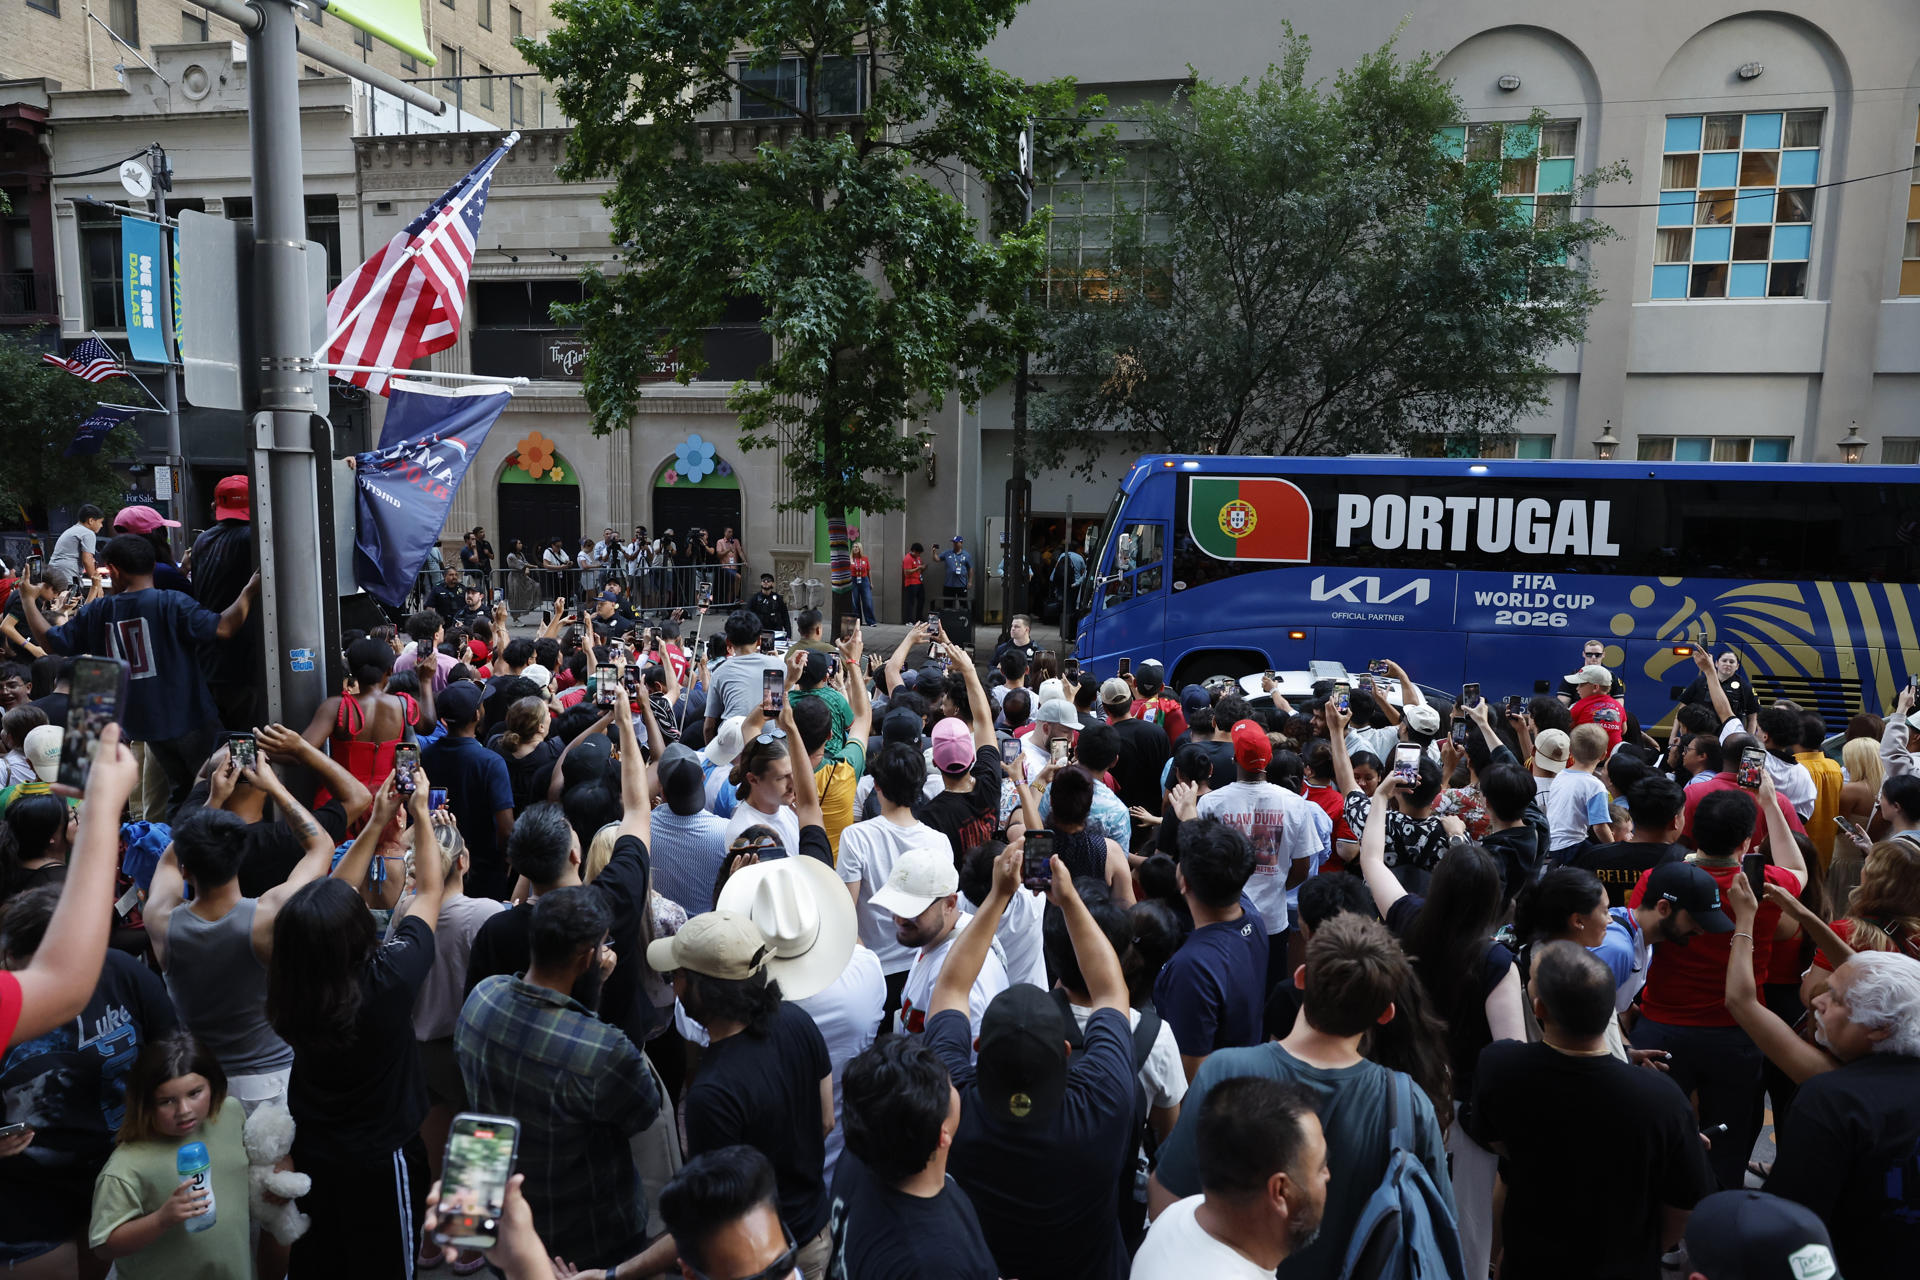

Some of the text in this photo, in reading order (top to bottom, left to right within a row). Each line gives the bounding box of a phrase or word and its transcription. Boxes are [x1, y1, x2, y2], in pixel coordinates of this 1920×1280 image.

[139, 255, 152, 287] WE
[129, 252, 141, 327] DALLAS
[549, 346, 564, 364] The
[126, 494, 154, 503] For Sale
[1336, 493, 1620, 557] PORTUGAL
[1512, 574, 1557, 591] FIFA
[1474, 591, 1595, 610] WORLD CUP
[1331, 611, 1405, 622] OFFICIAL PARTNER
[1494, 610, 1568, 628] 2026
[1223, 812, 1284, 826] SLAM DUNK
